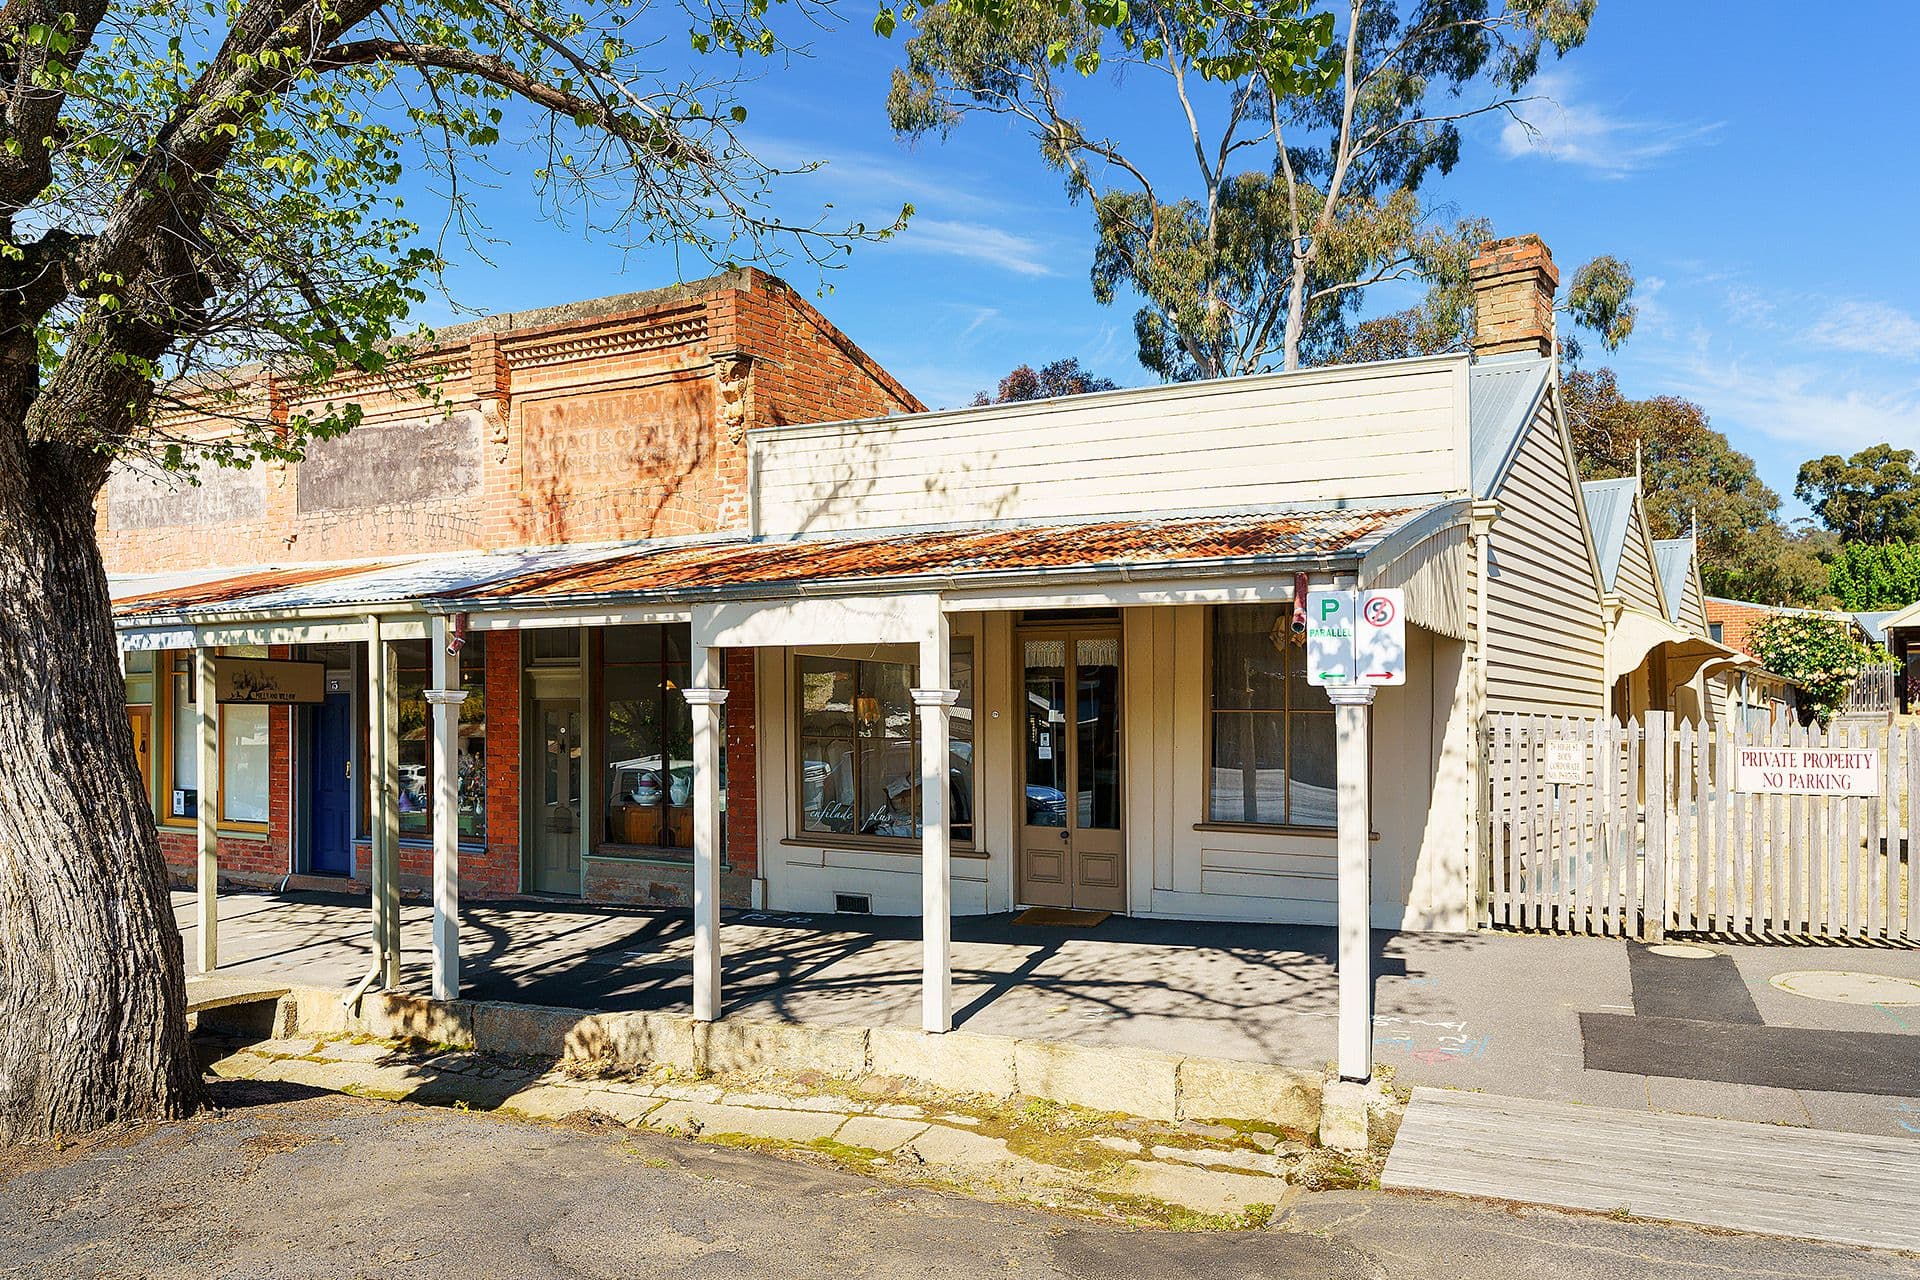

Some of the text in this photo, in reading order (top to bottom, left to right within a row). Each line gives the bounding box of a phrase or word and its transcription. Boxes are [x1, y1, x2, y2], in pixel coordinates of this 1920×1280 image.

[1321, 598, 1340, 621] P
[1309, 628, 1352, 638] PARALLEL
[1742, 751, 1873, 769] PRIVATE PROPERTY
[1762, 772, 1851, 790] NO PARKING
[806, 800, 892, 831] enfilade plus
